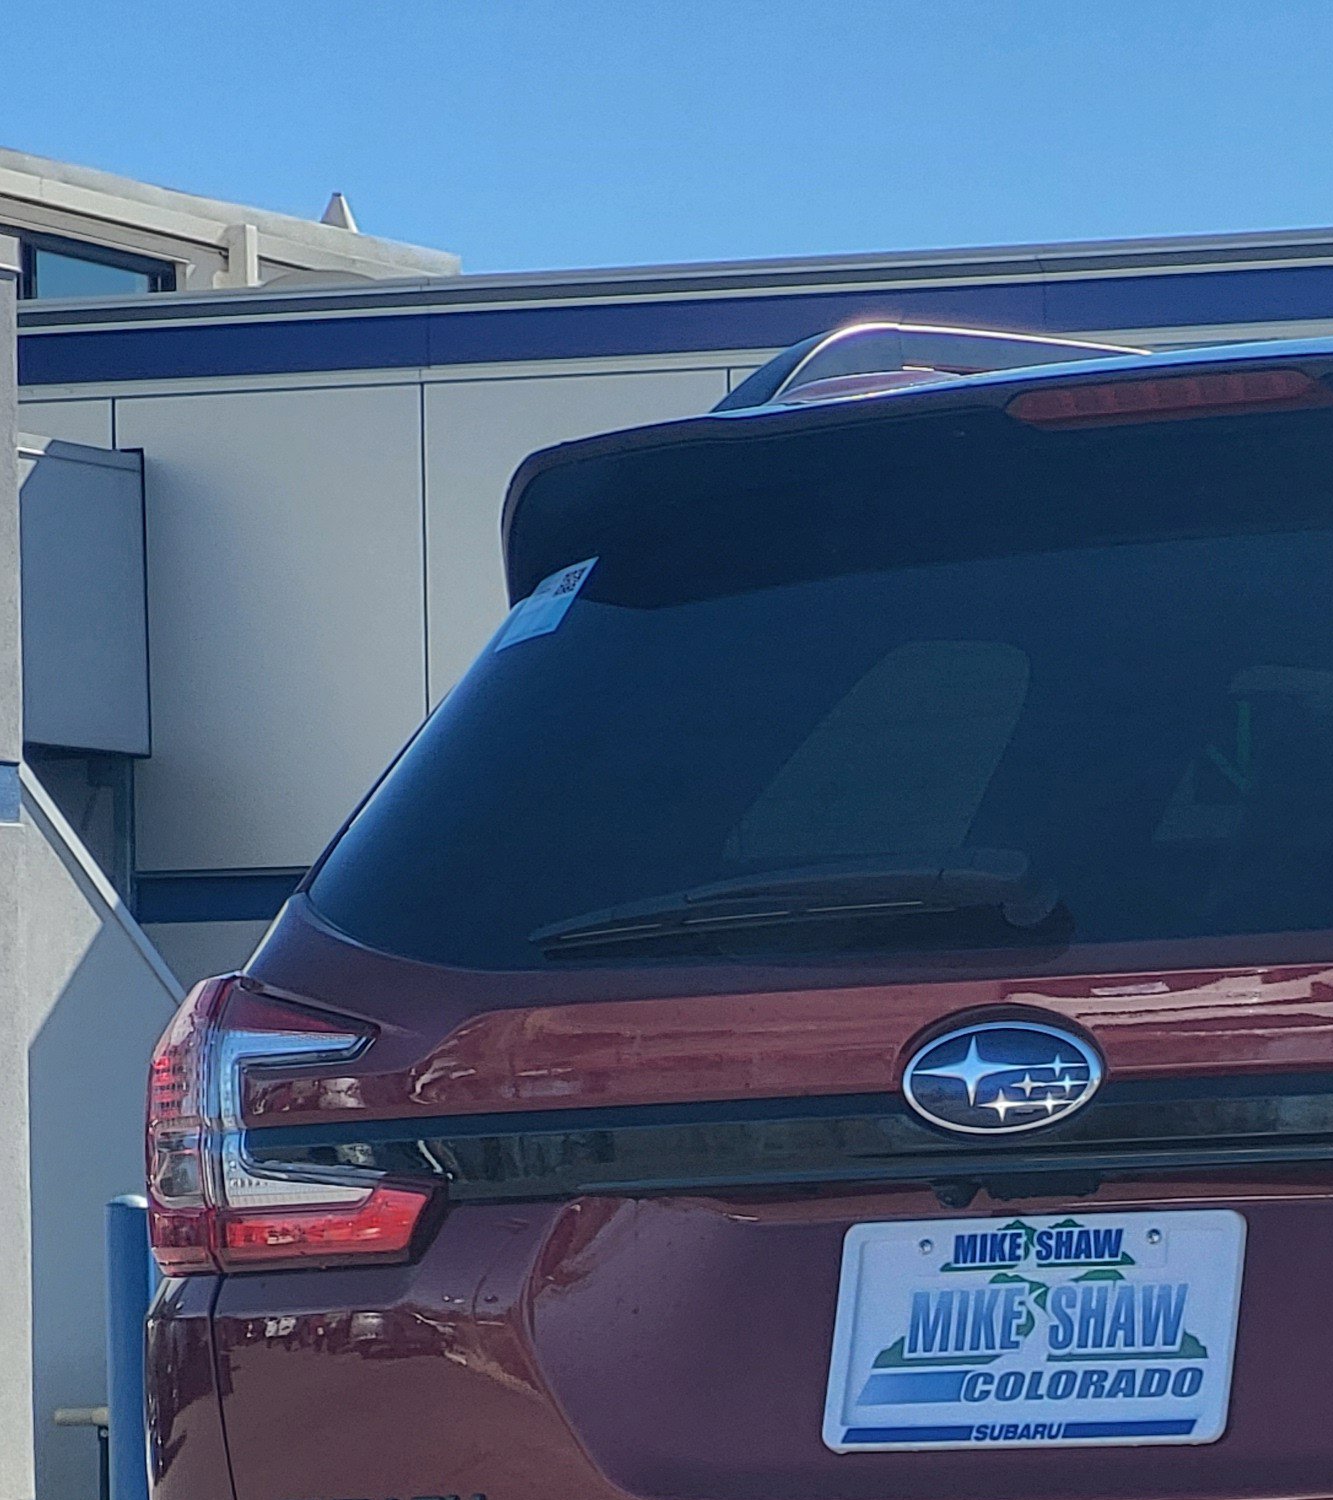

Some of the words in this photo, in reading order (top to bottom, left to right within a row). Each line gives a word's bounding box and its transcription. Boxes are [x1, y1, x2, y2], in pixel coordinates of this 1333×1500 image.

[953, 1232, 1024, 1265] MIKE
[1035, 1228, 1124, 1261] SHAW
[907, 1284, 1026, 1354] MIKE
[1047, 1282, 1189, 1351] SHAW
[961, 1366, 1204, 1403] COLORADO
[972, 1421, 1063, 1442] SUBARU
